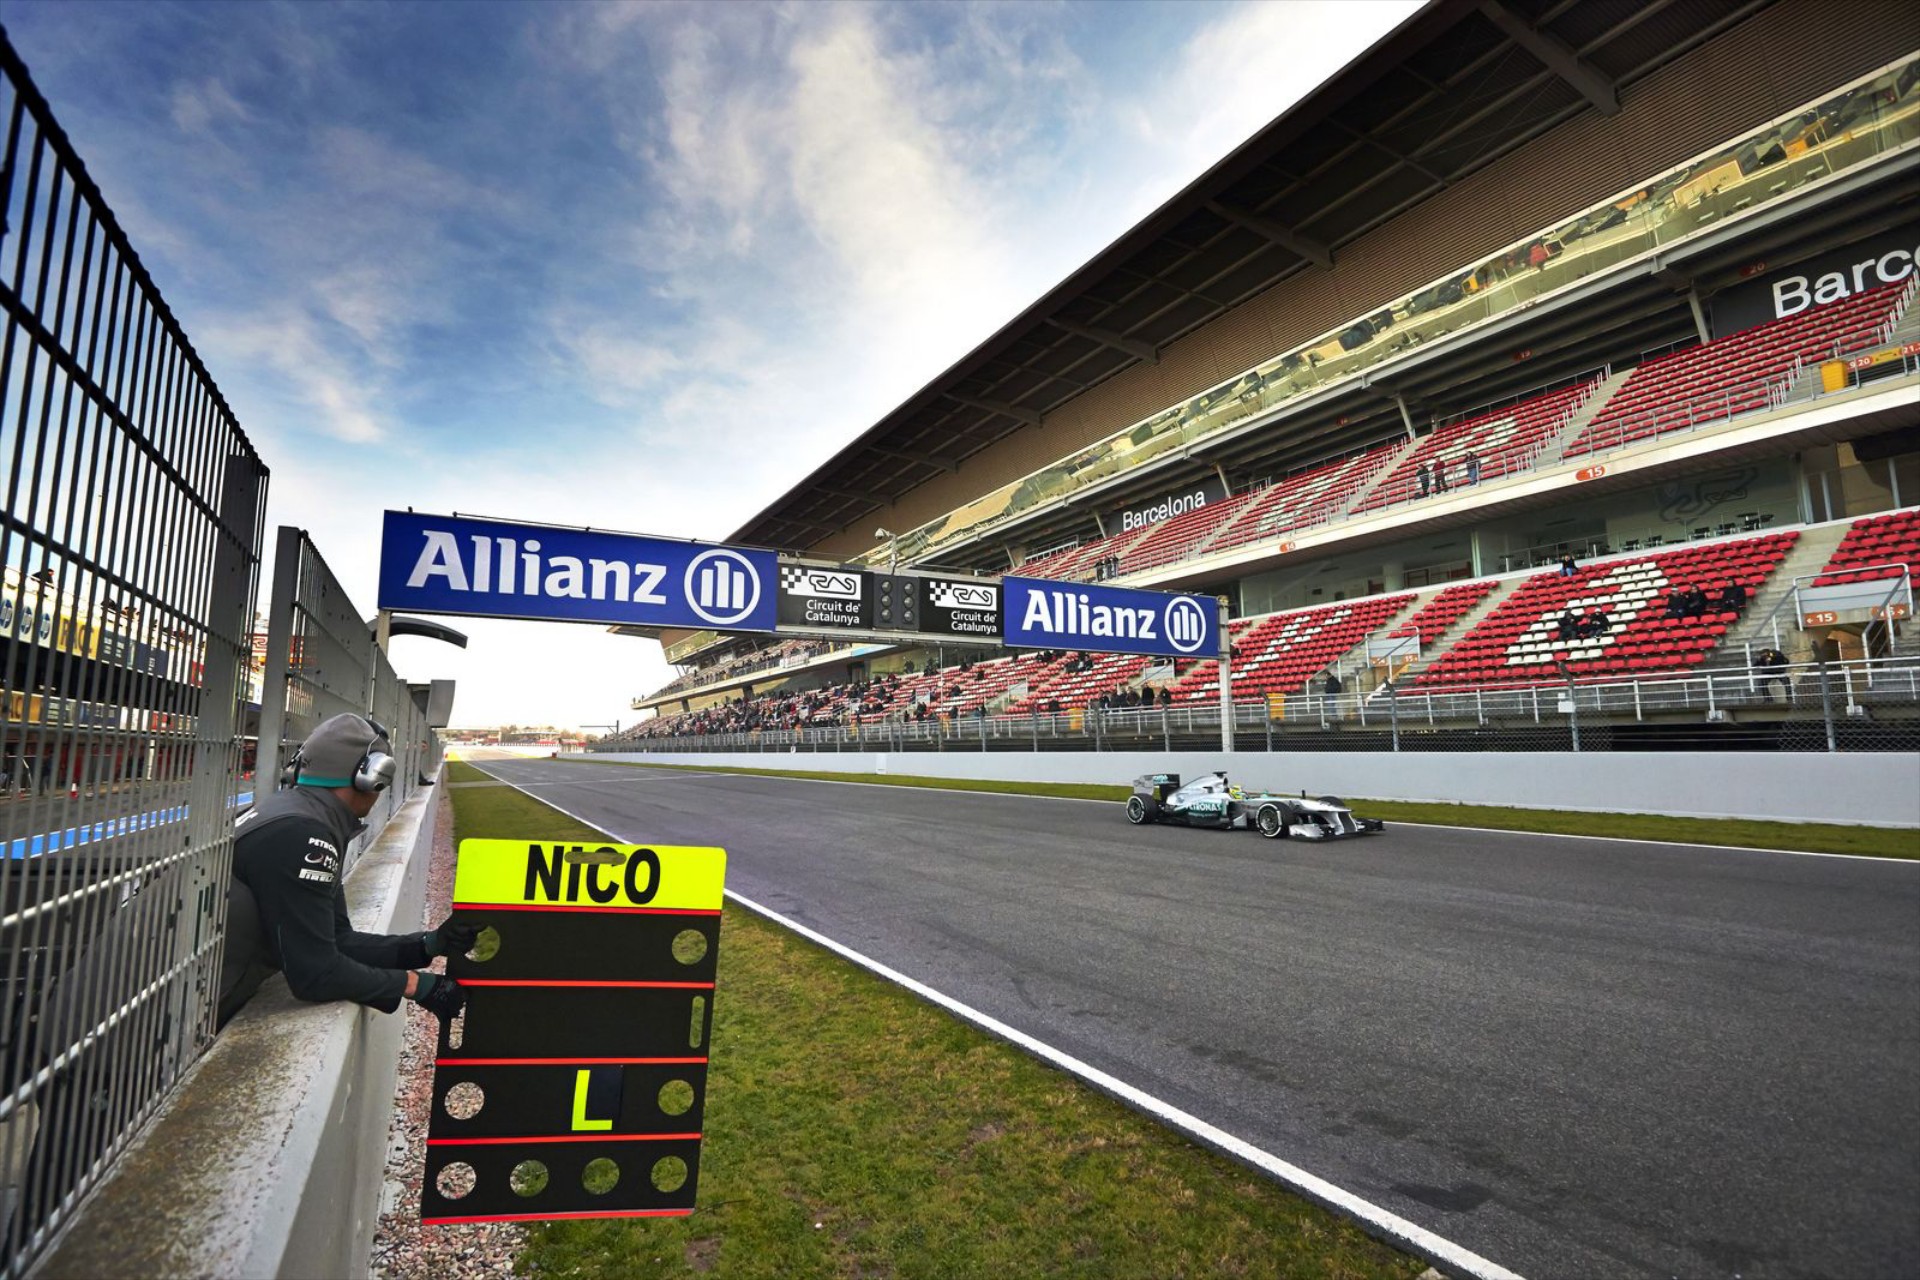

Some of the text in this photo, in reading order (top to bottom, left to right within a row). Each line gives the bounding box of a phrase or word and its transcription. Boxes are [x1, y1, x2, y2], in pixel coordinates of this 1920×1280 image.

[1772, 245, 1920, 319] Barc
[1587, 465, 1603, 478] 15
[1122, 491, 1206, 532] Barcelona
[407, 530, 667, 605] Allianz
[805, 610, 860, 626] Catalunya
[806, 599, 842, 611] Circuit
[951, 610, 982, 622] Circuit
[1021, 589, 1157, 639] Allianz
[1816, 613, 1833, 623] 15
[951, 621, 997, 635] Catalunya
[524, 844, 661, 904] NICO
[571, 1069, 613, 1131] L
